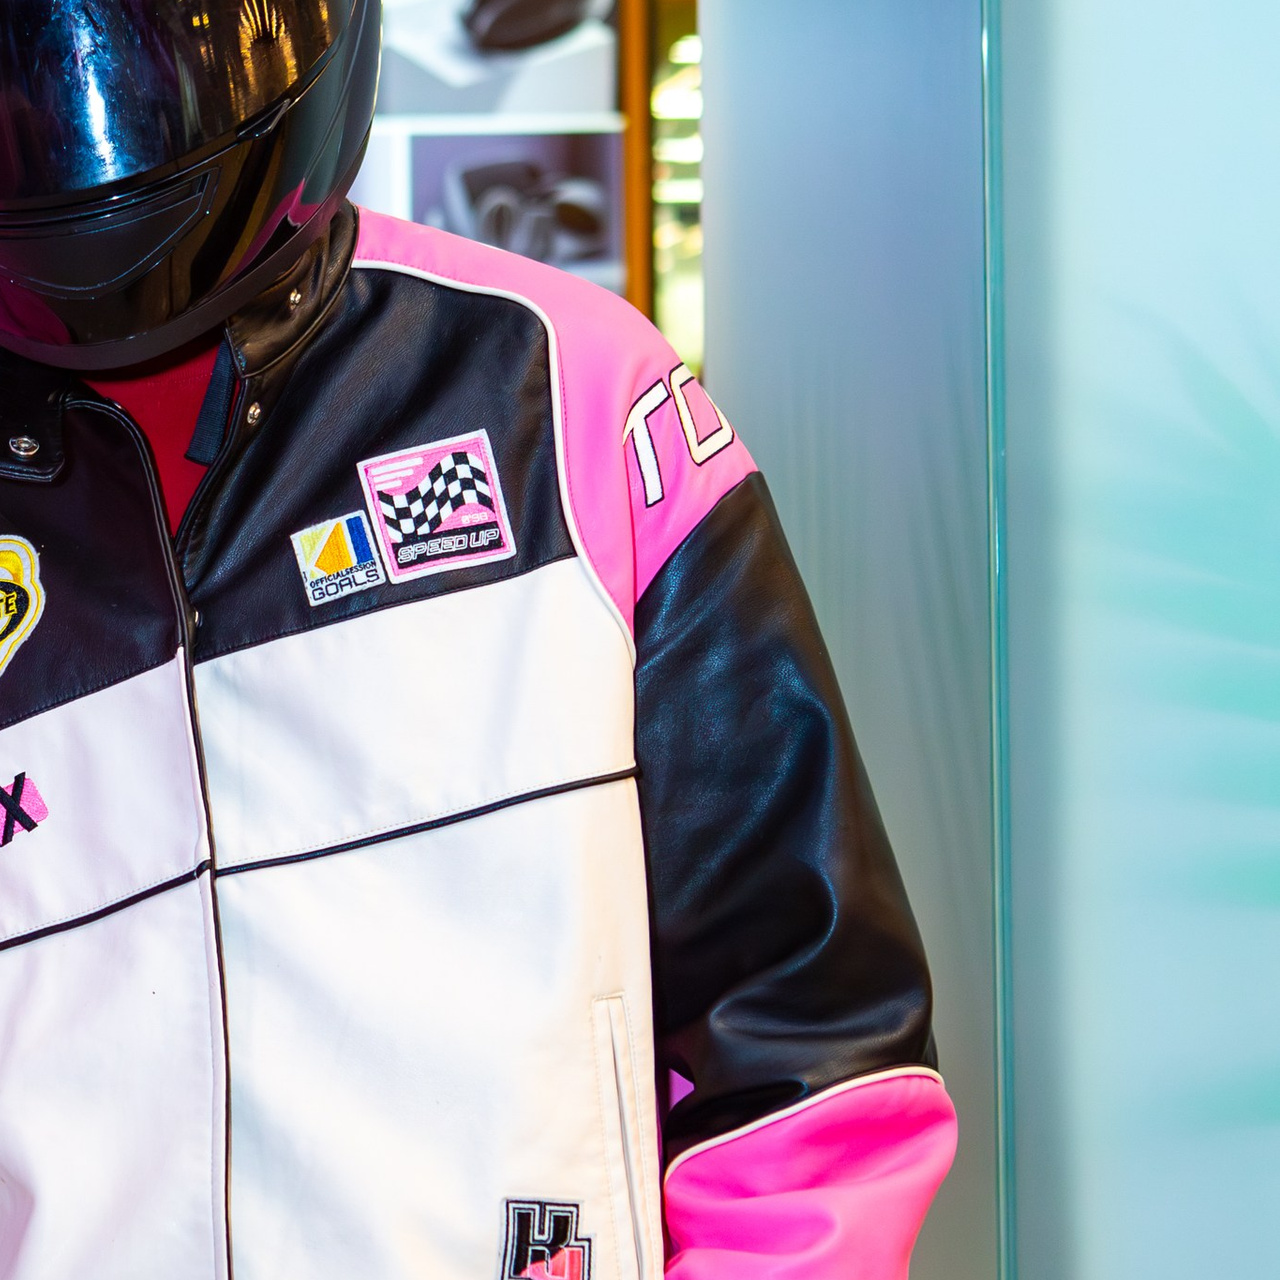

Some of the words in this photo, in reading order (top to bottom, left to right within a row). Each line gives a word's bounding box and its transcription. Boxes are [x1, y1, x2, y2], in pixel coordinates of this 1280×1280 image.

[398, 534, 468, 564] SPEED
[469, 528, 500, 548] UP
[311, 568, 380, 601] GOALS
